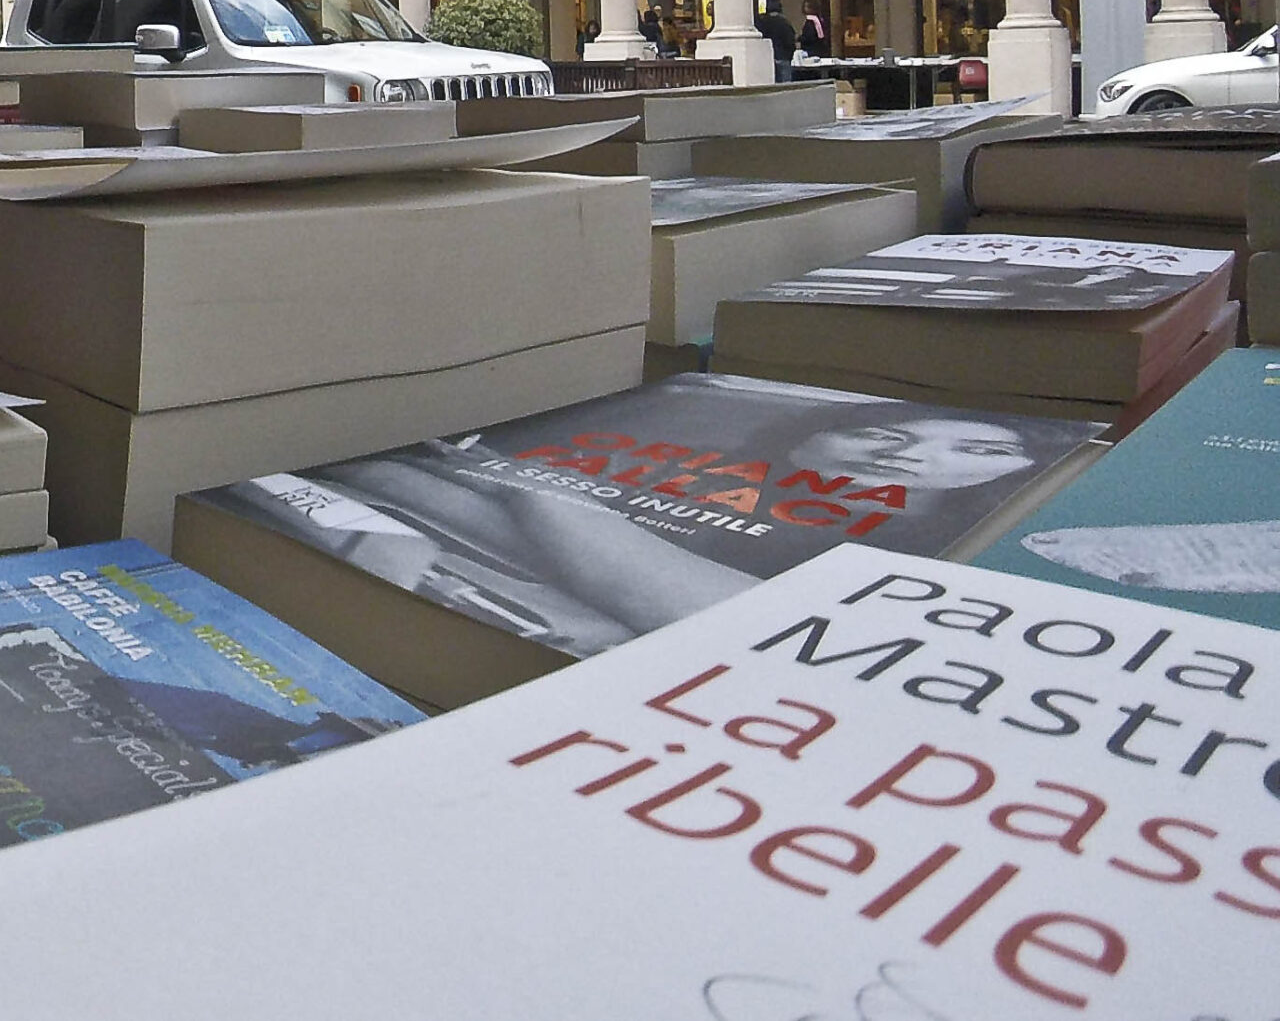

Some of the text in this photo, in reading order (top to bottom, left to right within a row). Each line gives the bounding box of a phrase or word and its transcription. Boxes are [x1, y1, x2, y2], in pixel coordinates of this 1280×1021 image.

[930, 242, 1181, 263] ORIANA
[480, 458, 773, 538] IL SESSO INUTILE
[516, 445, 893, 537] FALLACI
[572, 432, 908, 510] ORIANA
[633, 515, 697, 536] Botteri
[28, 574, 154, 662] BABILONIA
[60, 570, 140, 617] CAFFÈ
[839, 573, 1256, 700] Paola
[644, 662, 838, 761] La
[750, 614, 1280, 800] Mastr
[508, 727, 1130, 1011] ribelle
